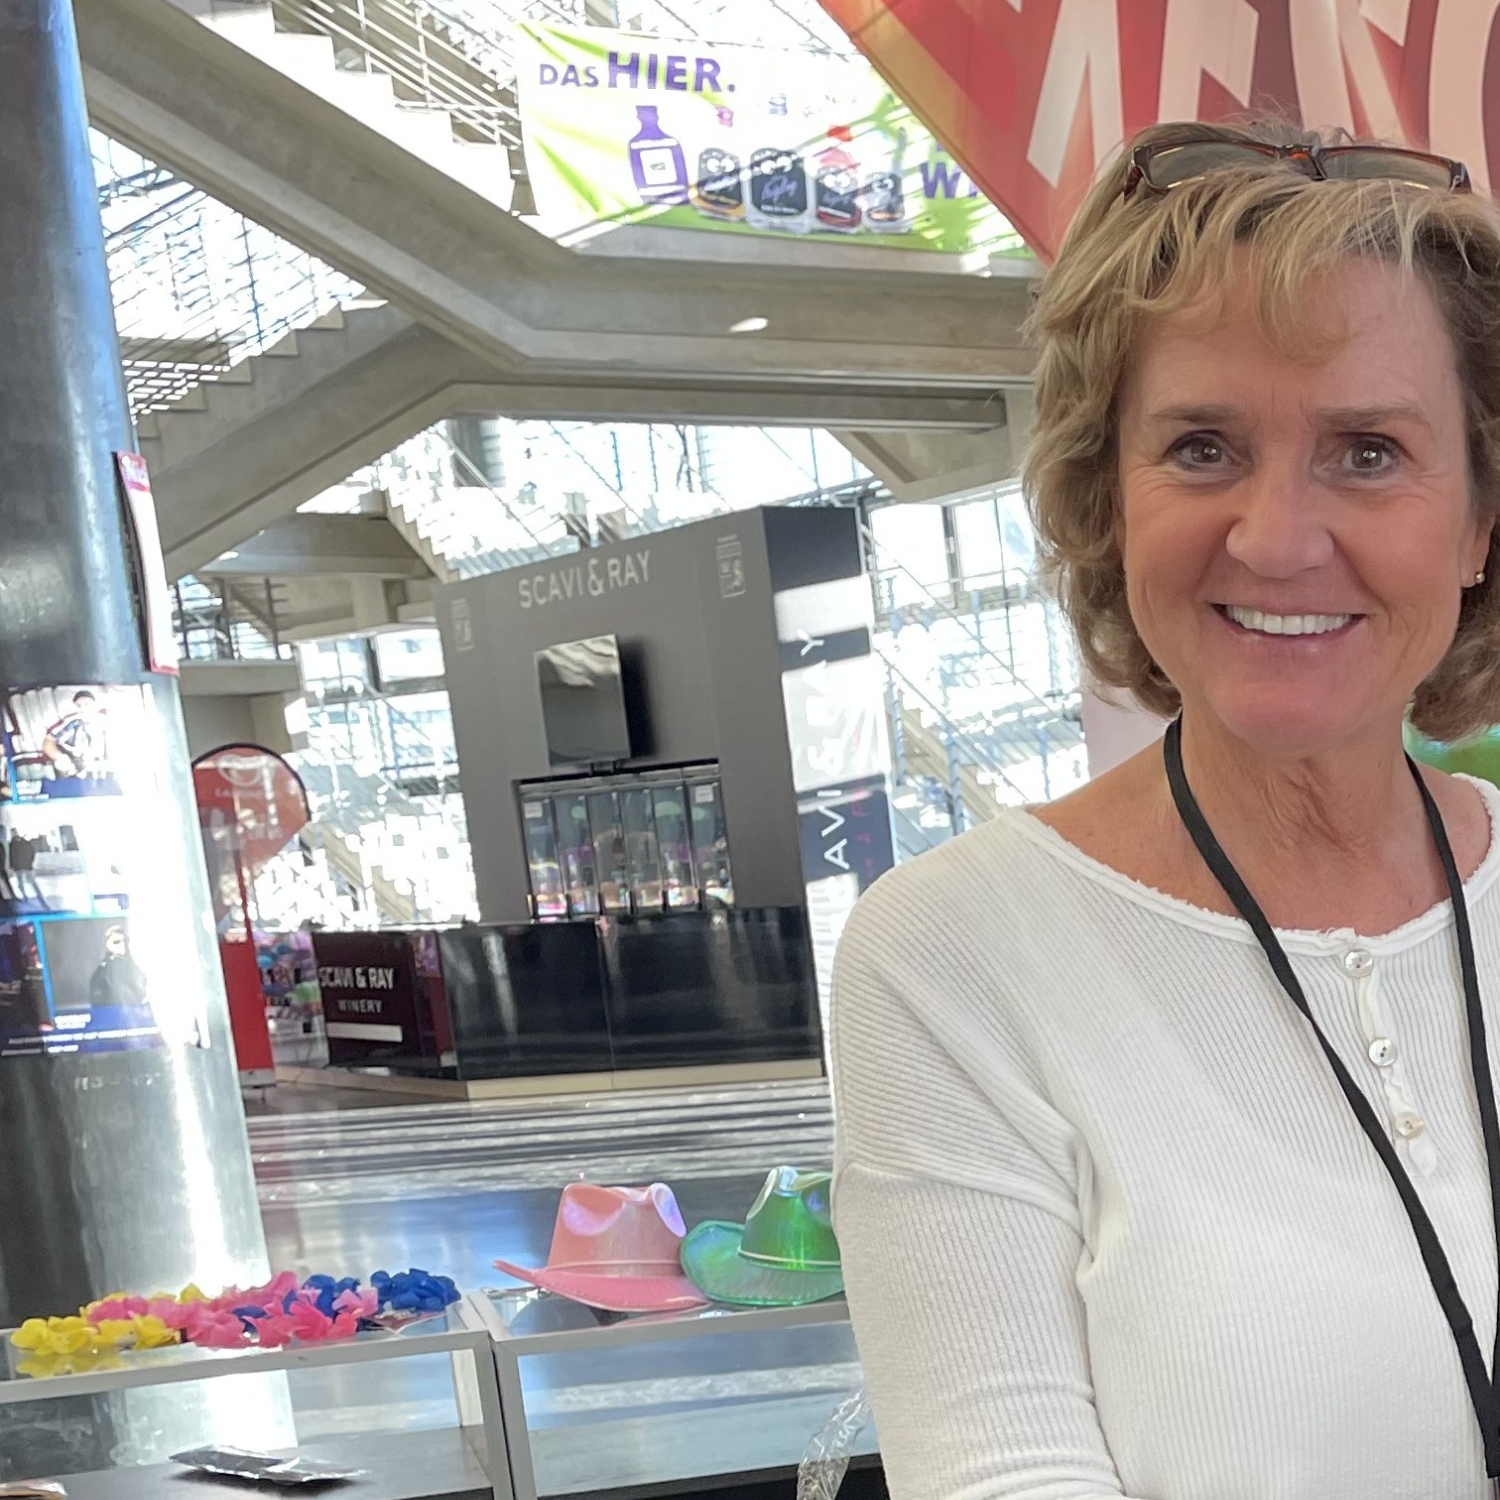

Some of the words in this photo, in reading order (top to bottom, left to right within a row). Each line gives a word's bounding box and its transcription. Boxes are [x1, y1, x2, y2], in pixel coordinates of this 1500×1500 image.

[539, 63, 599, 88] DAS
[608, 51, 736, 92] HIER.
[518, 566, 584, 609] SCAVI
[587, 557, 605, 596] &
[607, 550, 650, 590] RAY
[368, 967, 394, 989] RAY
